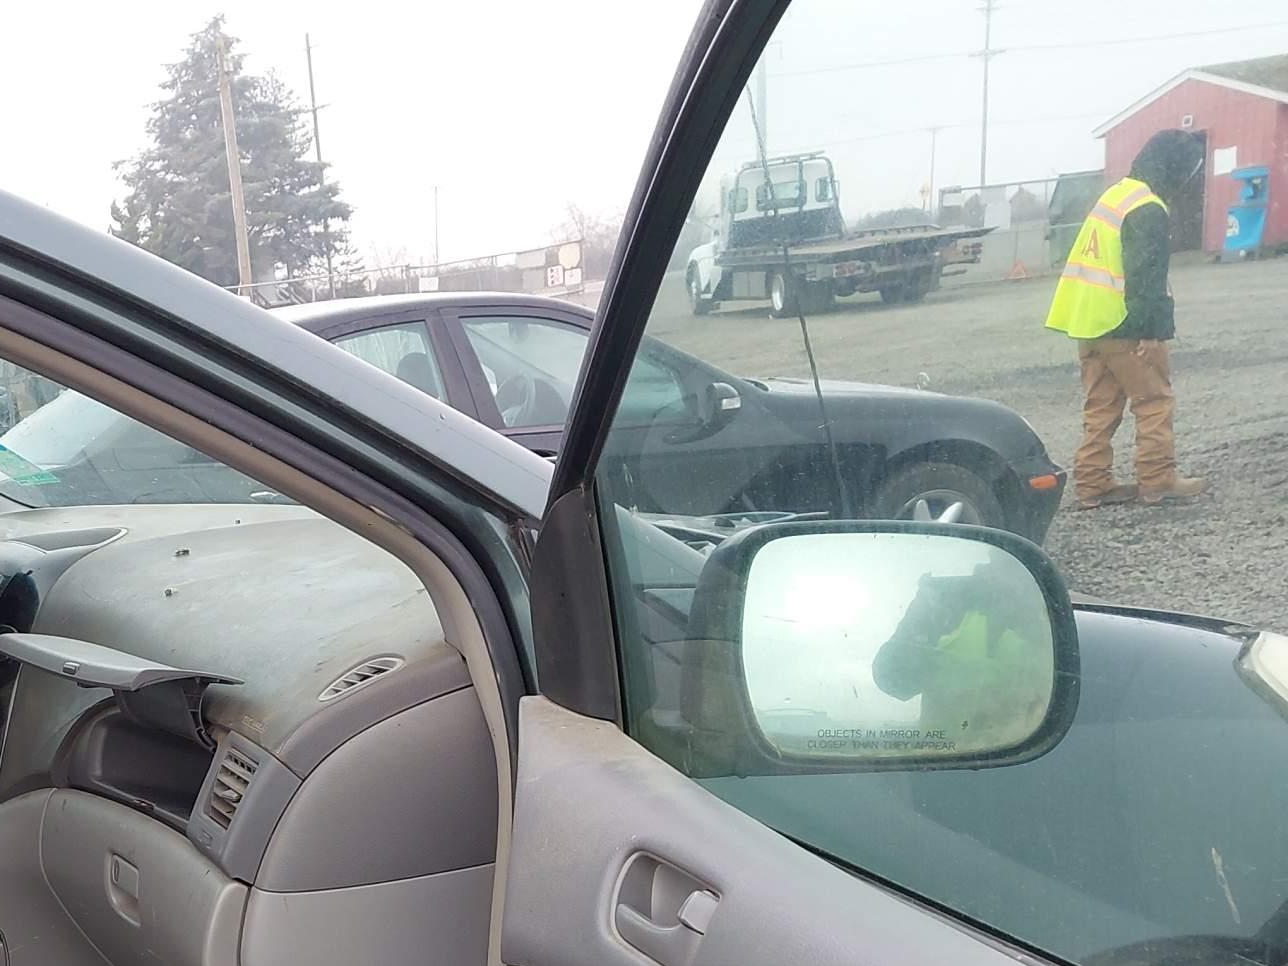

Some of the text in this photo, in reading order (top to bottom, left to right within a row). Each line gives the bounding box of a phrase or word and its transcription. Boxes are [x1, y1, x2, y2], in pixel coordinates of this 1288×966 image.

[817, 729, 946, 739] OBJECTS IN MIRROR ARE
[808, 740, 956, 751] CLOSER THAN THEY APPEAR
